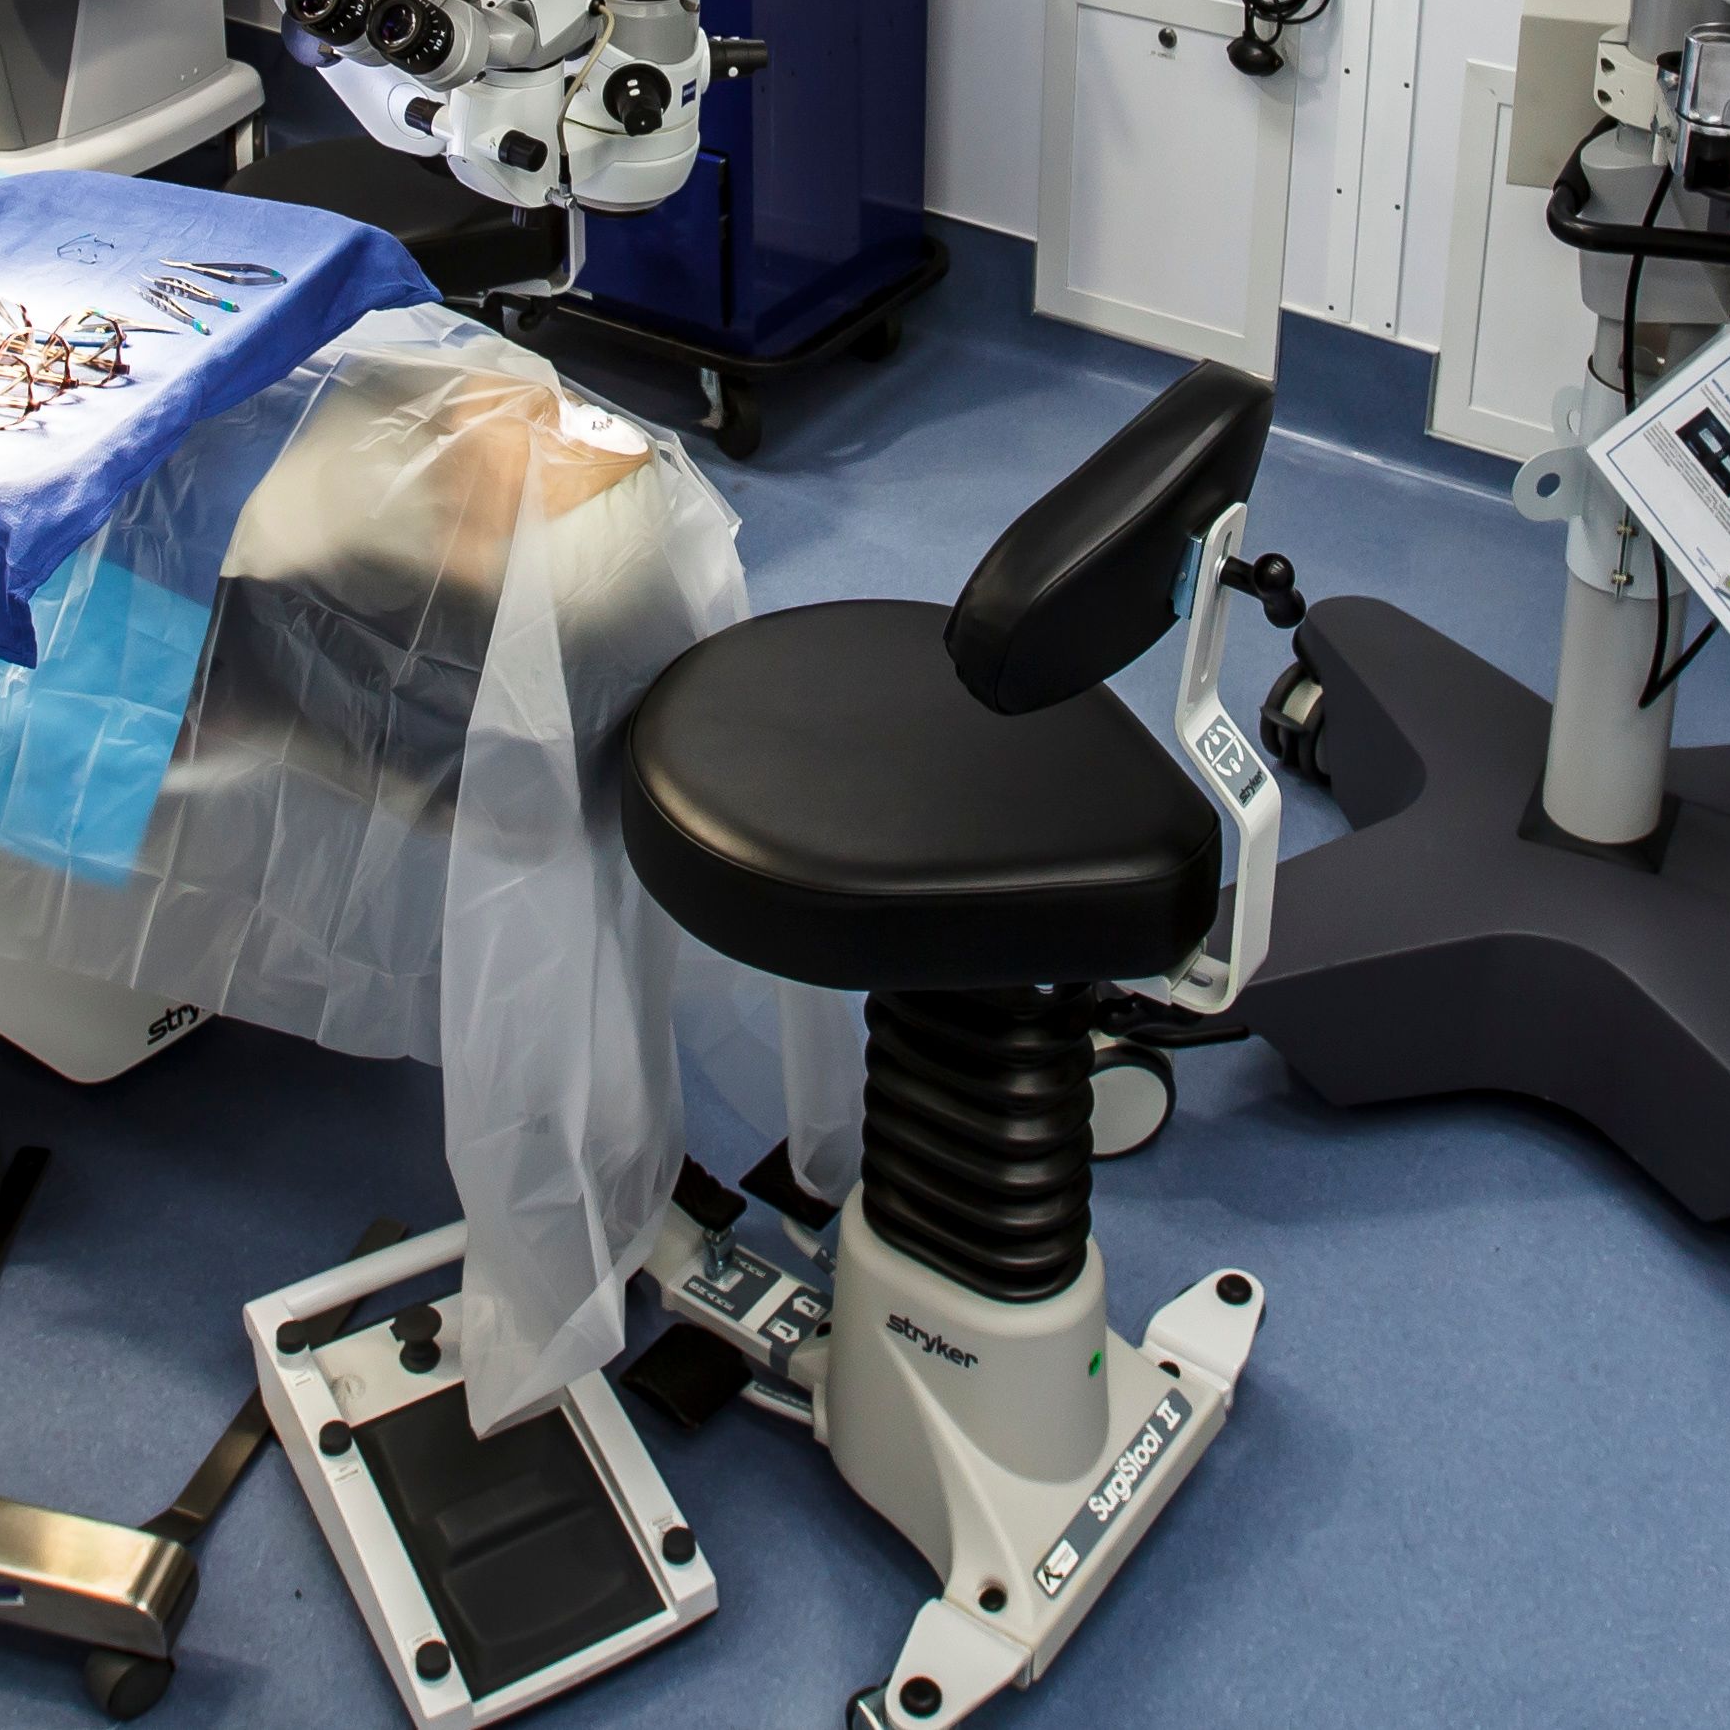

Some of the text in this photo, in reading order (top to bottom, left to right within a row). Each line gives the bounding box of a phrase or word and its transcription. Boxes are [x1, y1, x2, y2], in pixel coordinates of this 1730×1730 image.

[1239, 768, 1263, 806] stryker
[886, 1313, 979, 1369] stryker
[1087, 1423, 1164, 1522] SurgiStool
